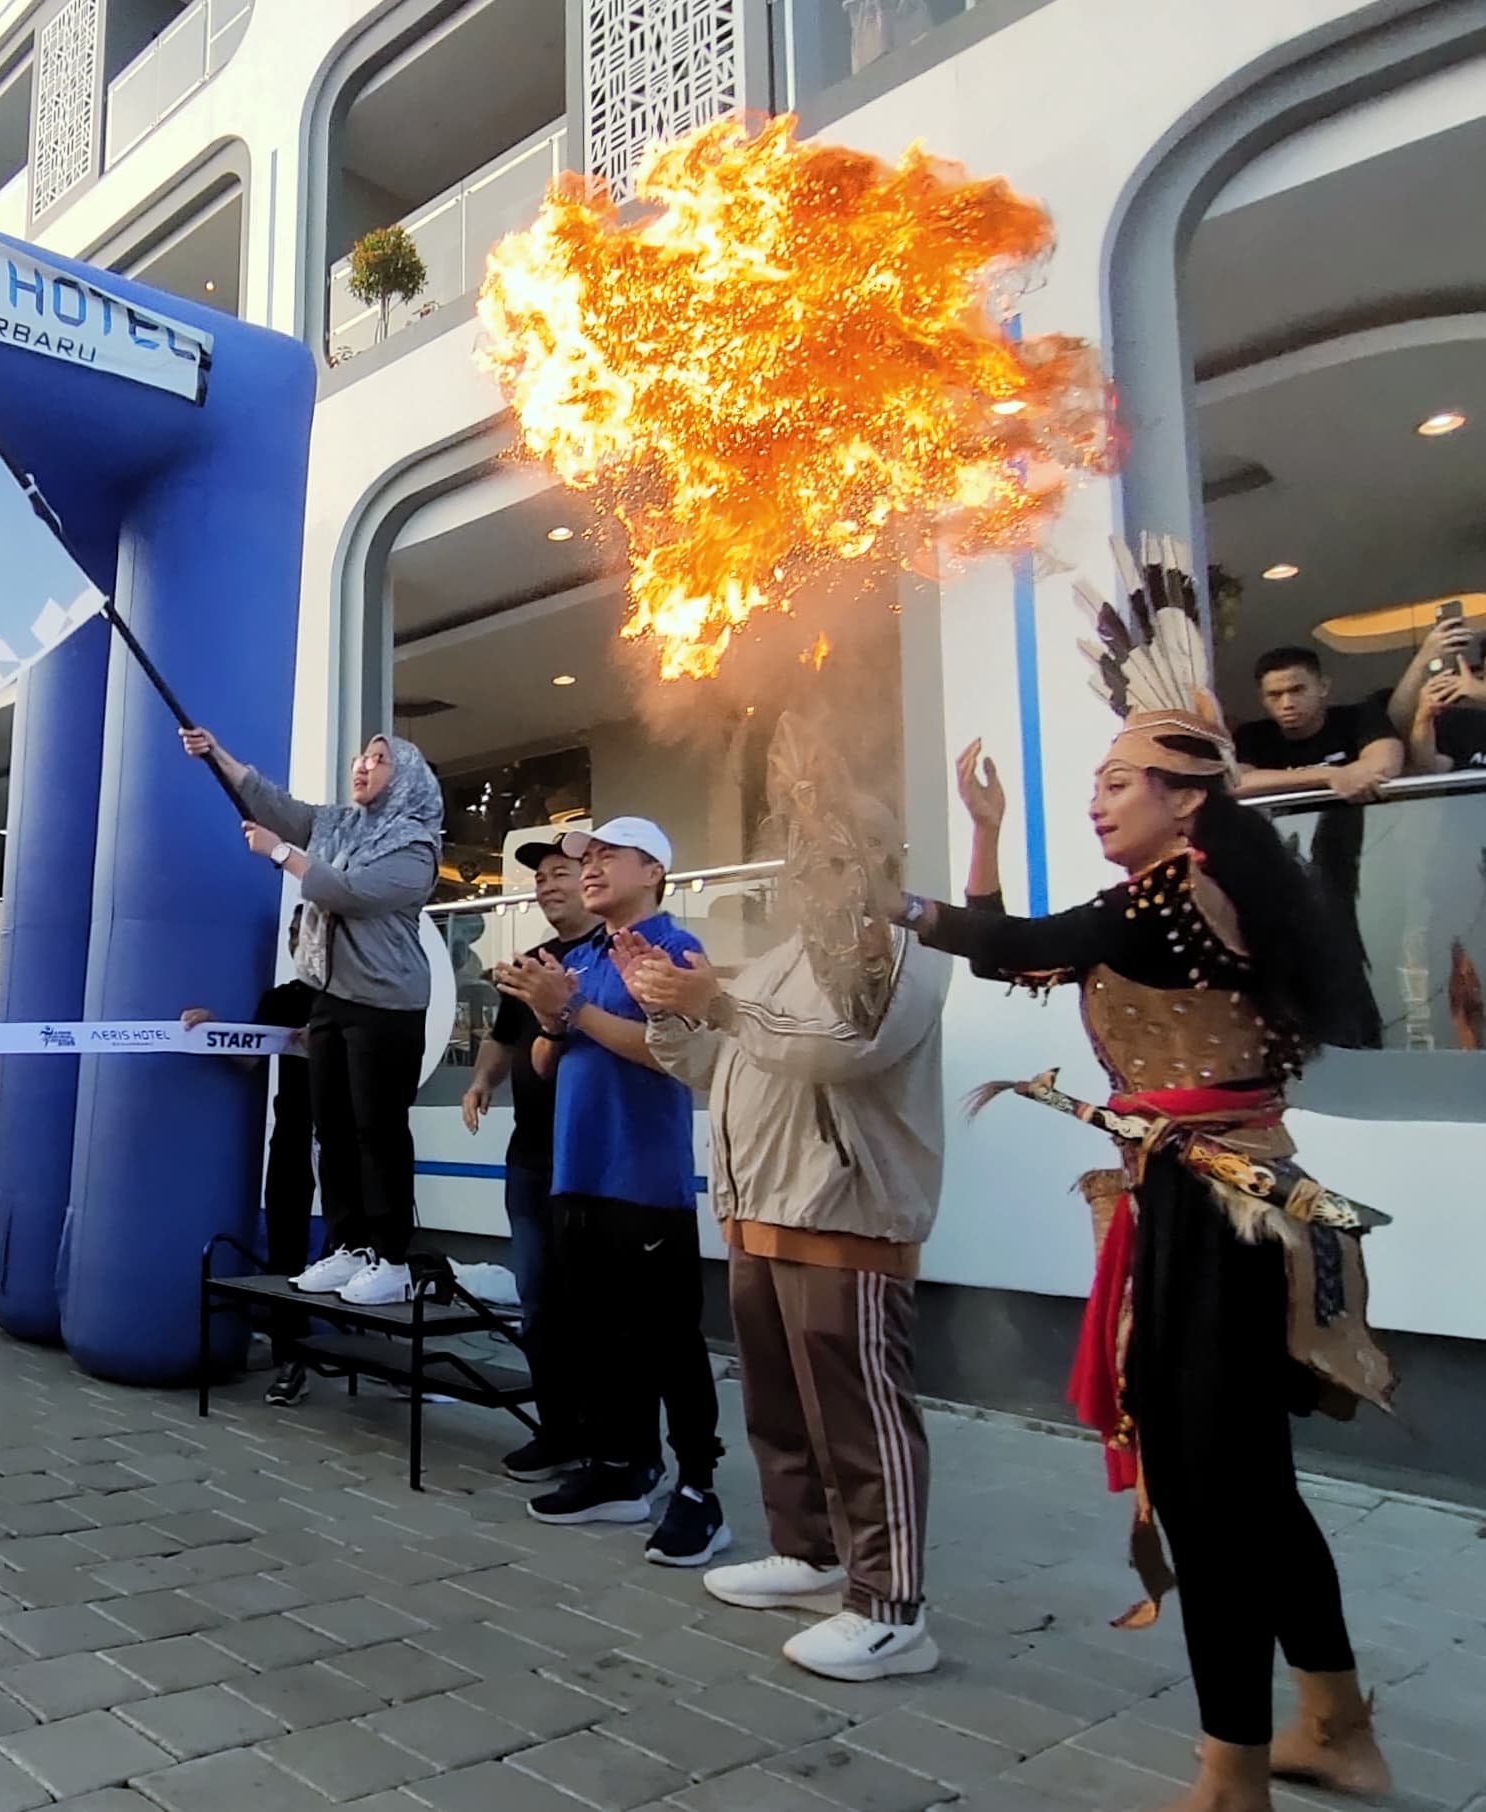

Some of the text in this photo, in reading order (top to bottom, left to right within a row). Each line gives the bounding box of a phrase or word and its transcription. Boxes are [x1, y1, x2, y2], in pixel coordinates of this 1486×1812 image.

[7, 258, 198, 362] HOTEL
[90, 1029, 131, 1041] AERIS
[133, 1029, 171, 1041] HOTEL
[206, 1031, 267, 1049] START
